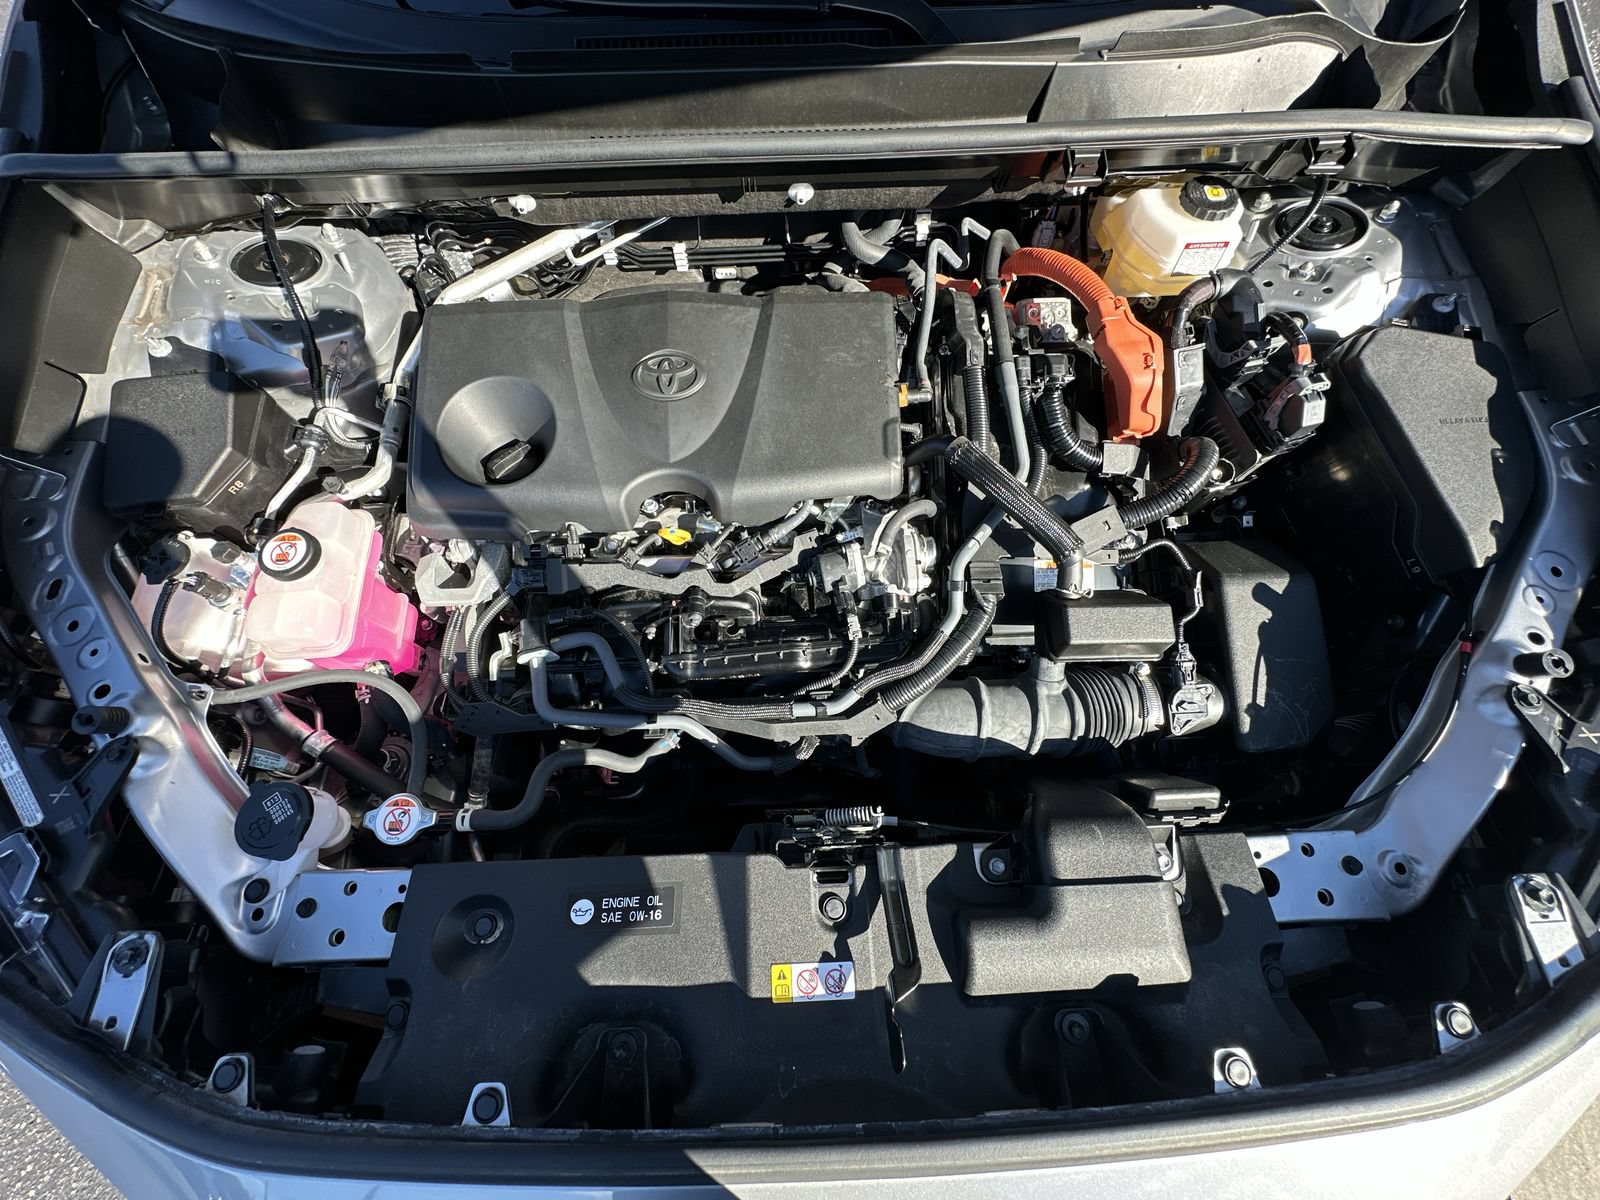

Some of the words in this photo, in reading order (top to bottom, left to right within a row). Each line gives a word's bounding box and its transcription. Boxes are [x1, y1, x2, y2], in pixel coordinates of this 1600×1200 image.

[228, 480, 244, 494] R8
[602, 896, 640, 909] ENGINE
[646, 895, 663, 906] OIL
[600, 911, 623, 923] SAE
[629, 909, 662, 922] 0W-16
